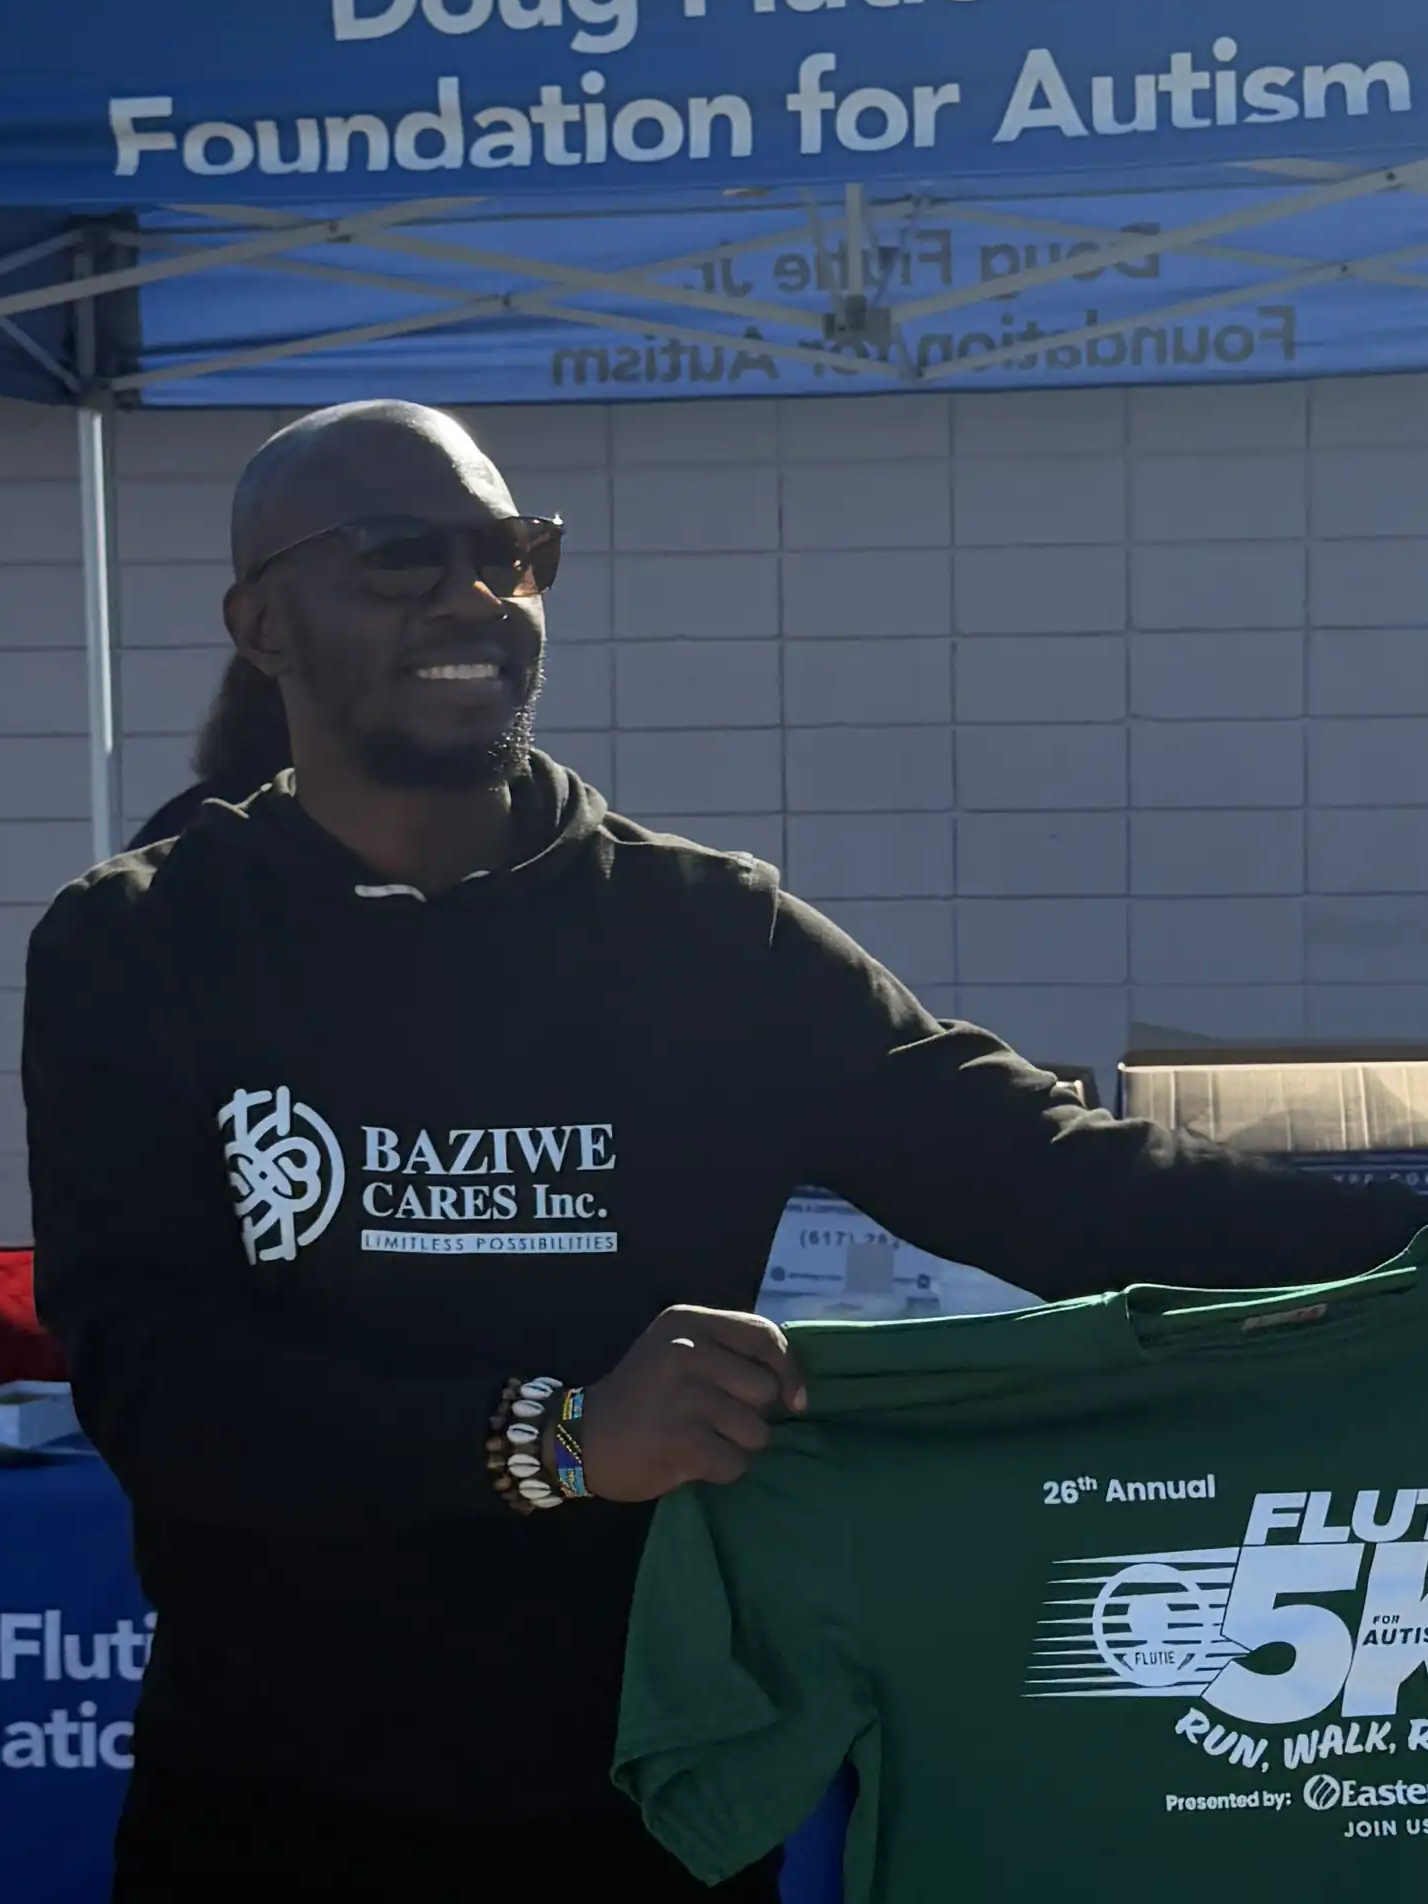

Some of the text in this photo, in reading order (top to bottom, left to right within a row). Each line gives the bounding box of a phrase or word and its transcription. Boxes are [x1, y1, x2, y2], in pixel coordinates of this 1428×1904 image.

[108, 36, 1412, 177] Foundation for Autism
[361, 1123, 617, 1176] BAZIWE
[362, 1181, 609, 1221] CARES Inc.
[364, 1234, 615, 1252] LIMITLESS POSSIBILITIES
[1042, 1473, 1216, 1505] 26th Annual
[1372, 1614, 1400, 1625] FOR
[1134, 1650, 1176, 1665] FLUTIE
[1174, 1707, 1270, 1773] RUN,
[1283, 1721, 1397, 1770] WALK,
[1165, 1790, 1292, 1812] Presented by:
[1343, 1819, 1398, 1838] JOIN
